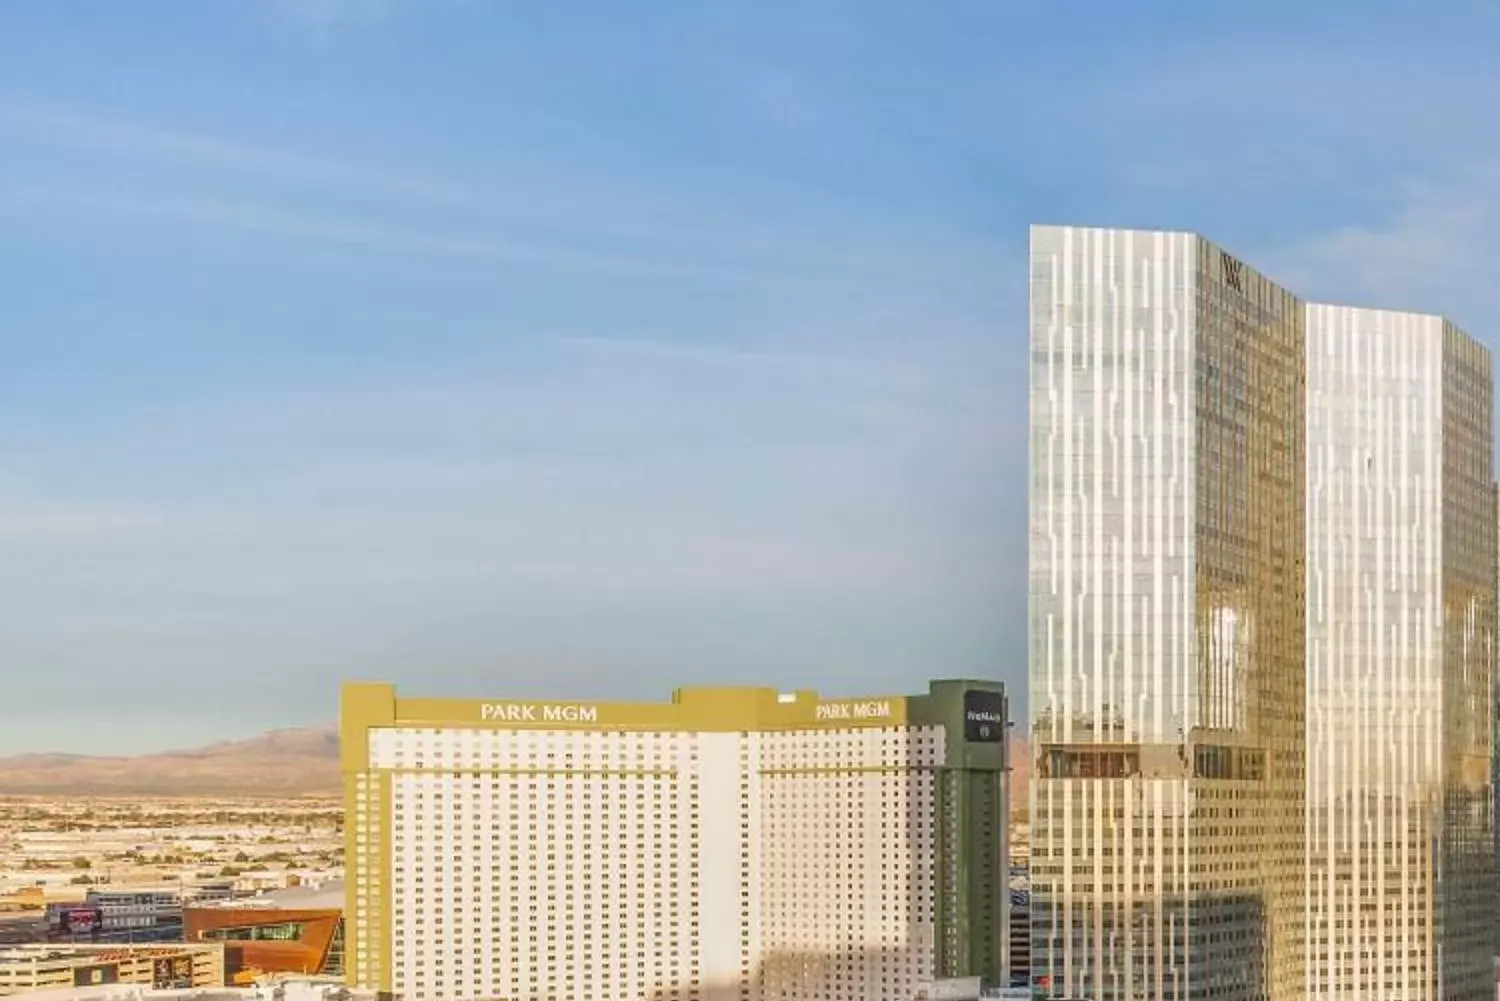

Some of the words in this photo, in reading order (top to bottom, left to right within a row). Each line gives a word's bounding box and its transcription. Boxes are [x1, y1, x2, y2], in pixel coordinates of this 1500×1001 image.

[481, 703, 536, 721] PARK
[543, 706, 597, 721] MGM
[816, 703, 849, 719] PARK
[854, 701, 889, 718] MGM
